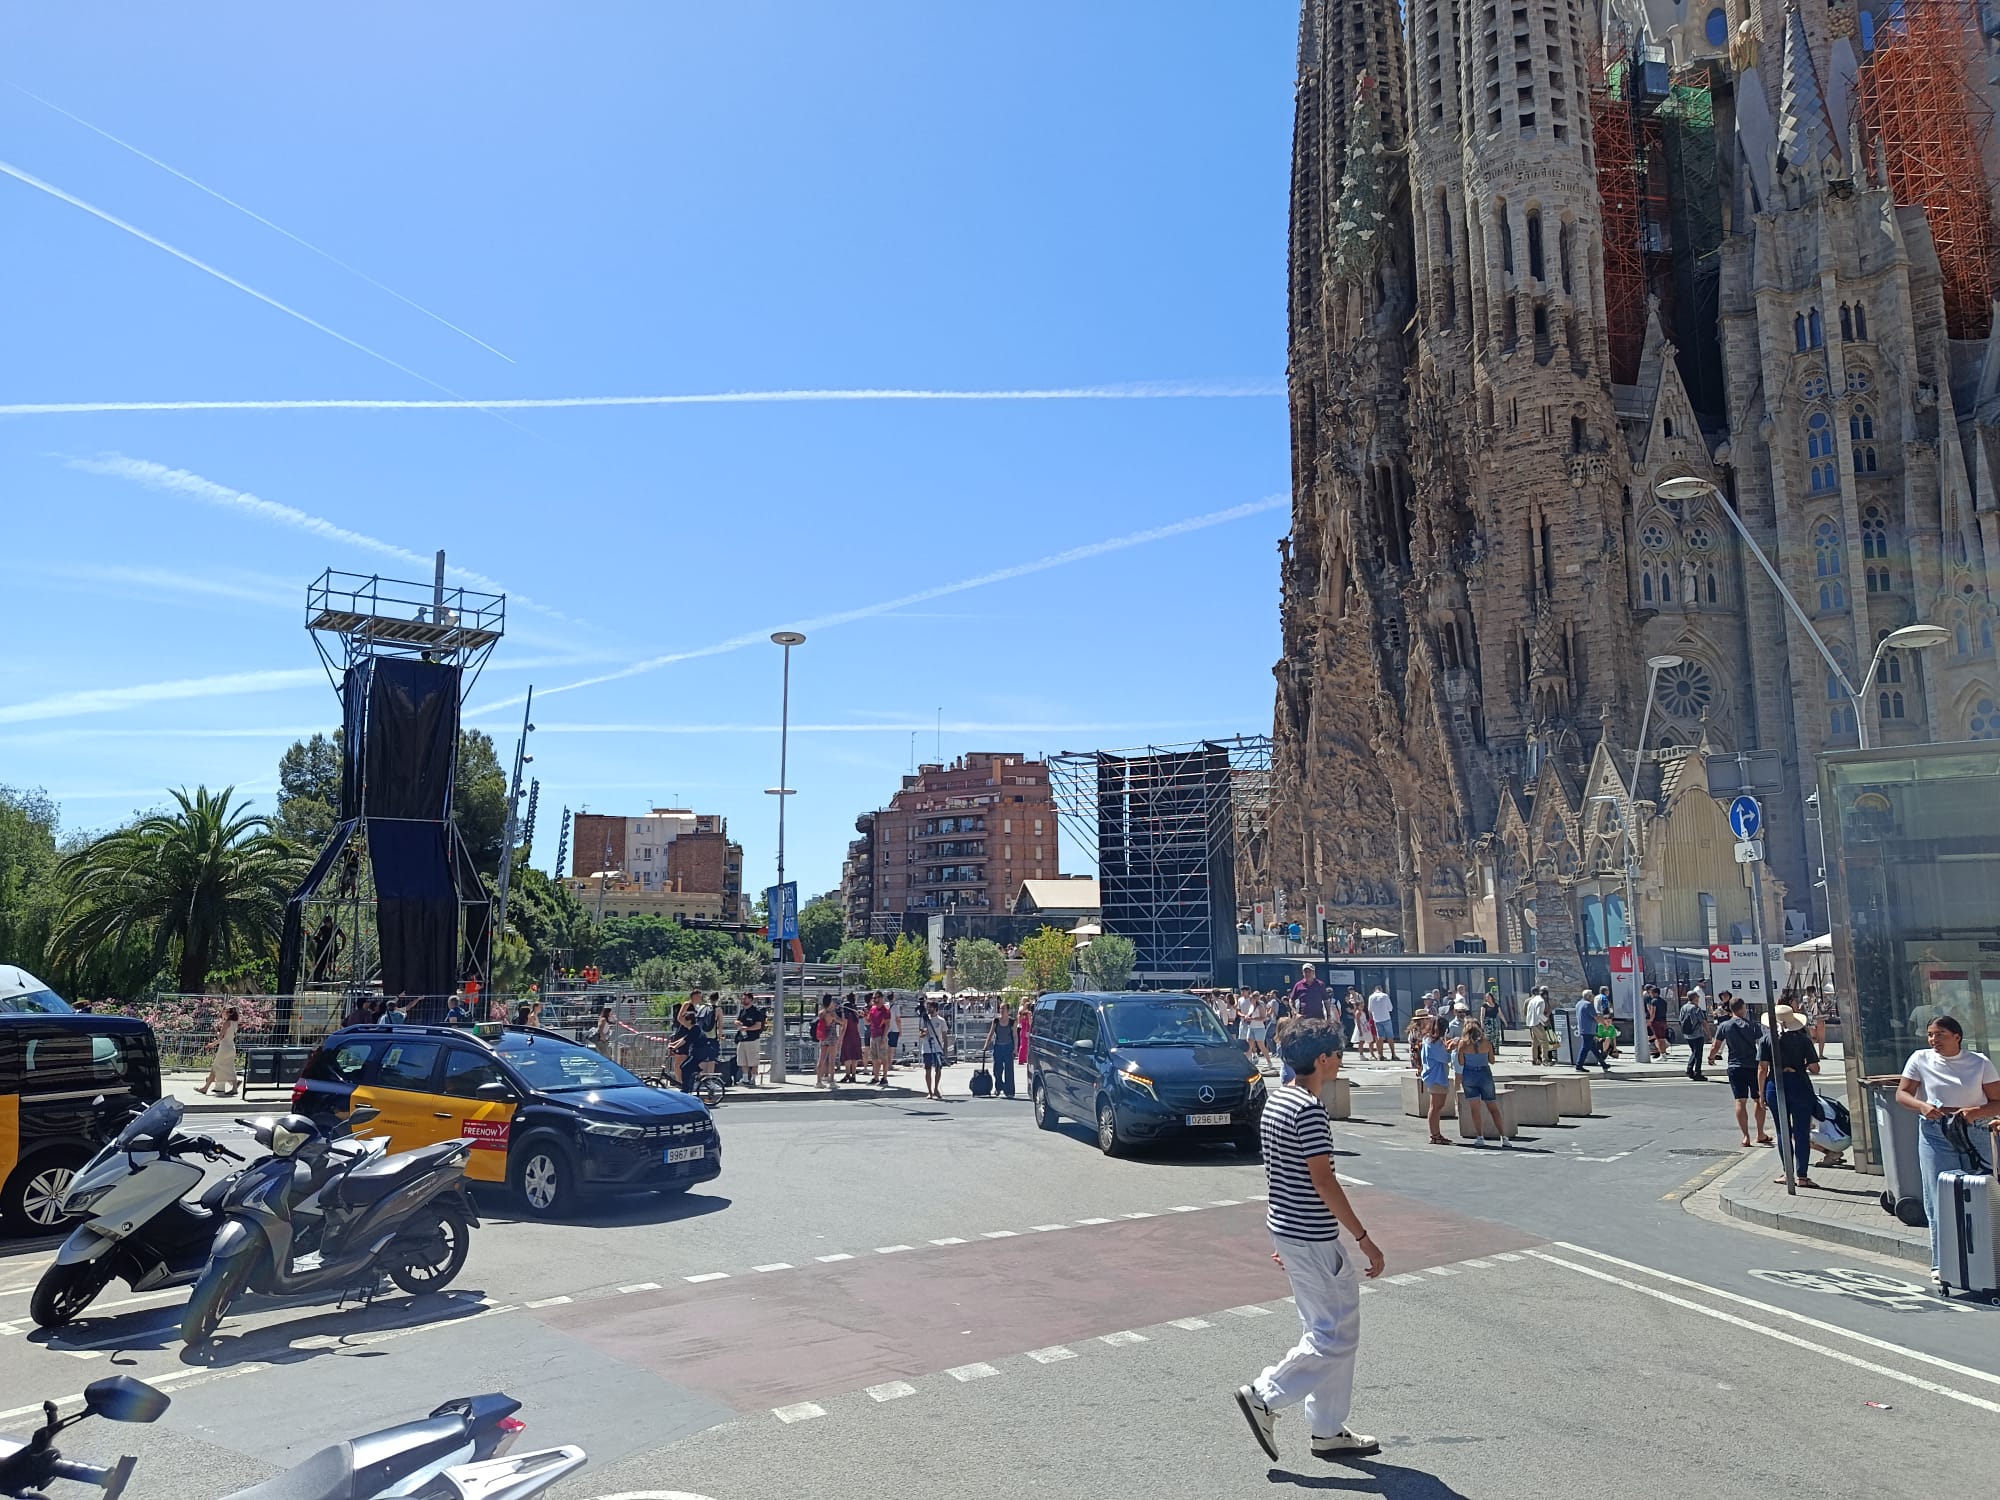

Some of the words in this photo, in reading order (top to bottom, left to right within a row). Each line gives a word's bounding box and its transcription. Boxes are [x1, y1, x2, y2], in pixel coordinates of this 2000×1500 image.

[1192, 1115, 1212, 1124] 0296
[1213, 1114, 1228, 1124] LPY
[669, 1149, 688, 1161] 9967
